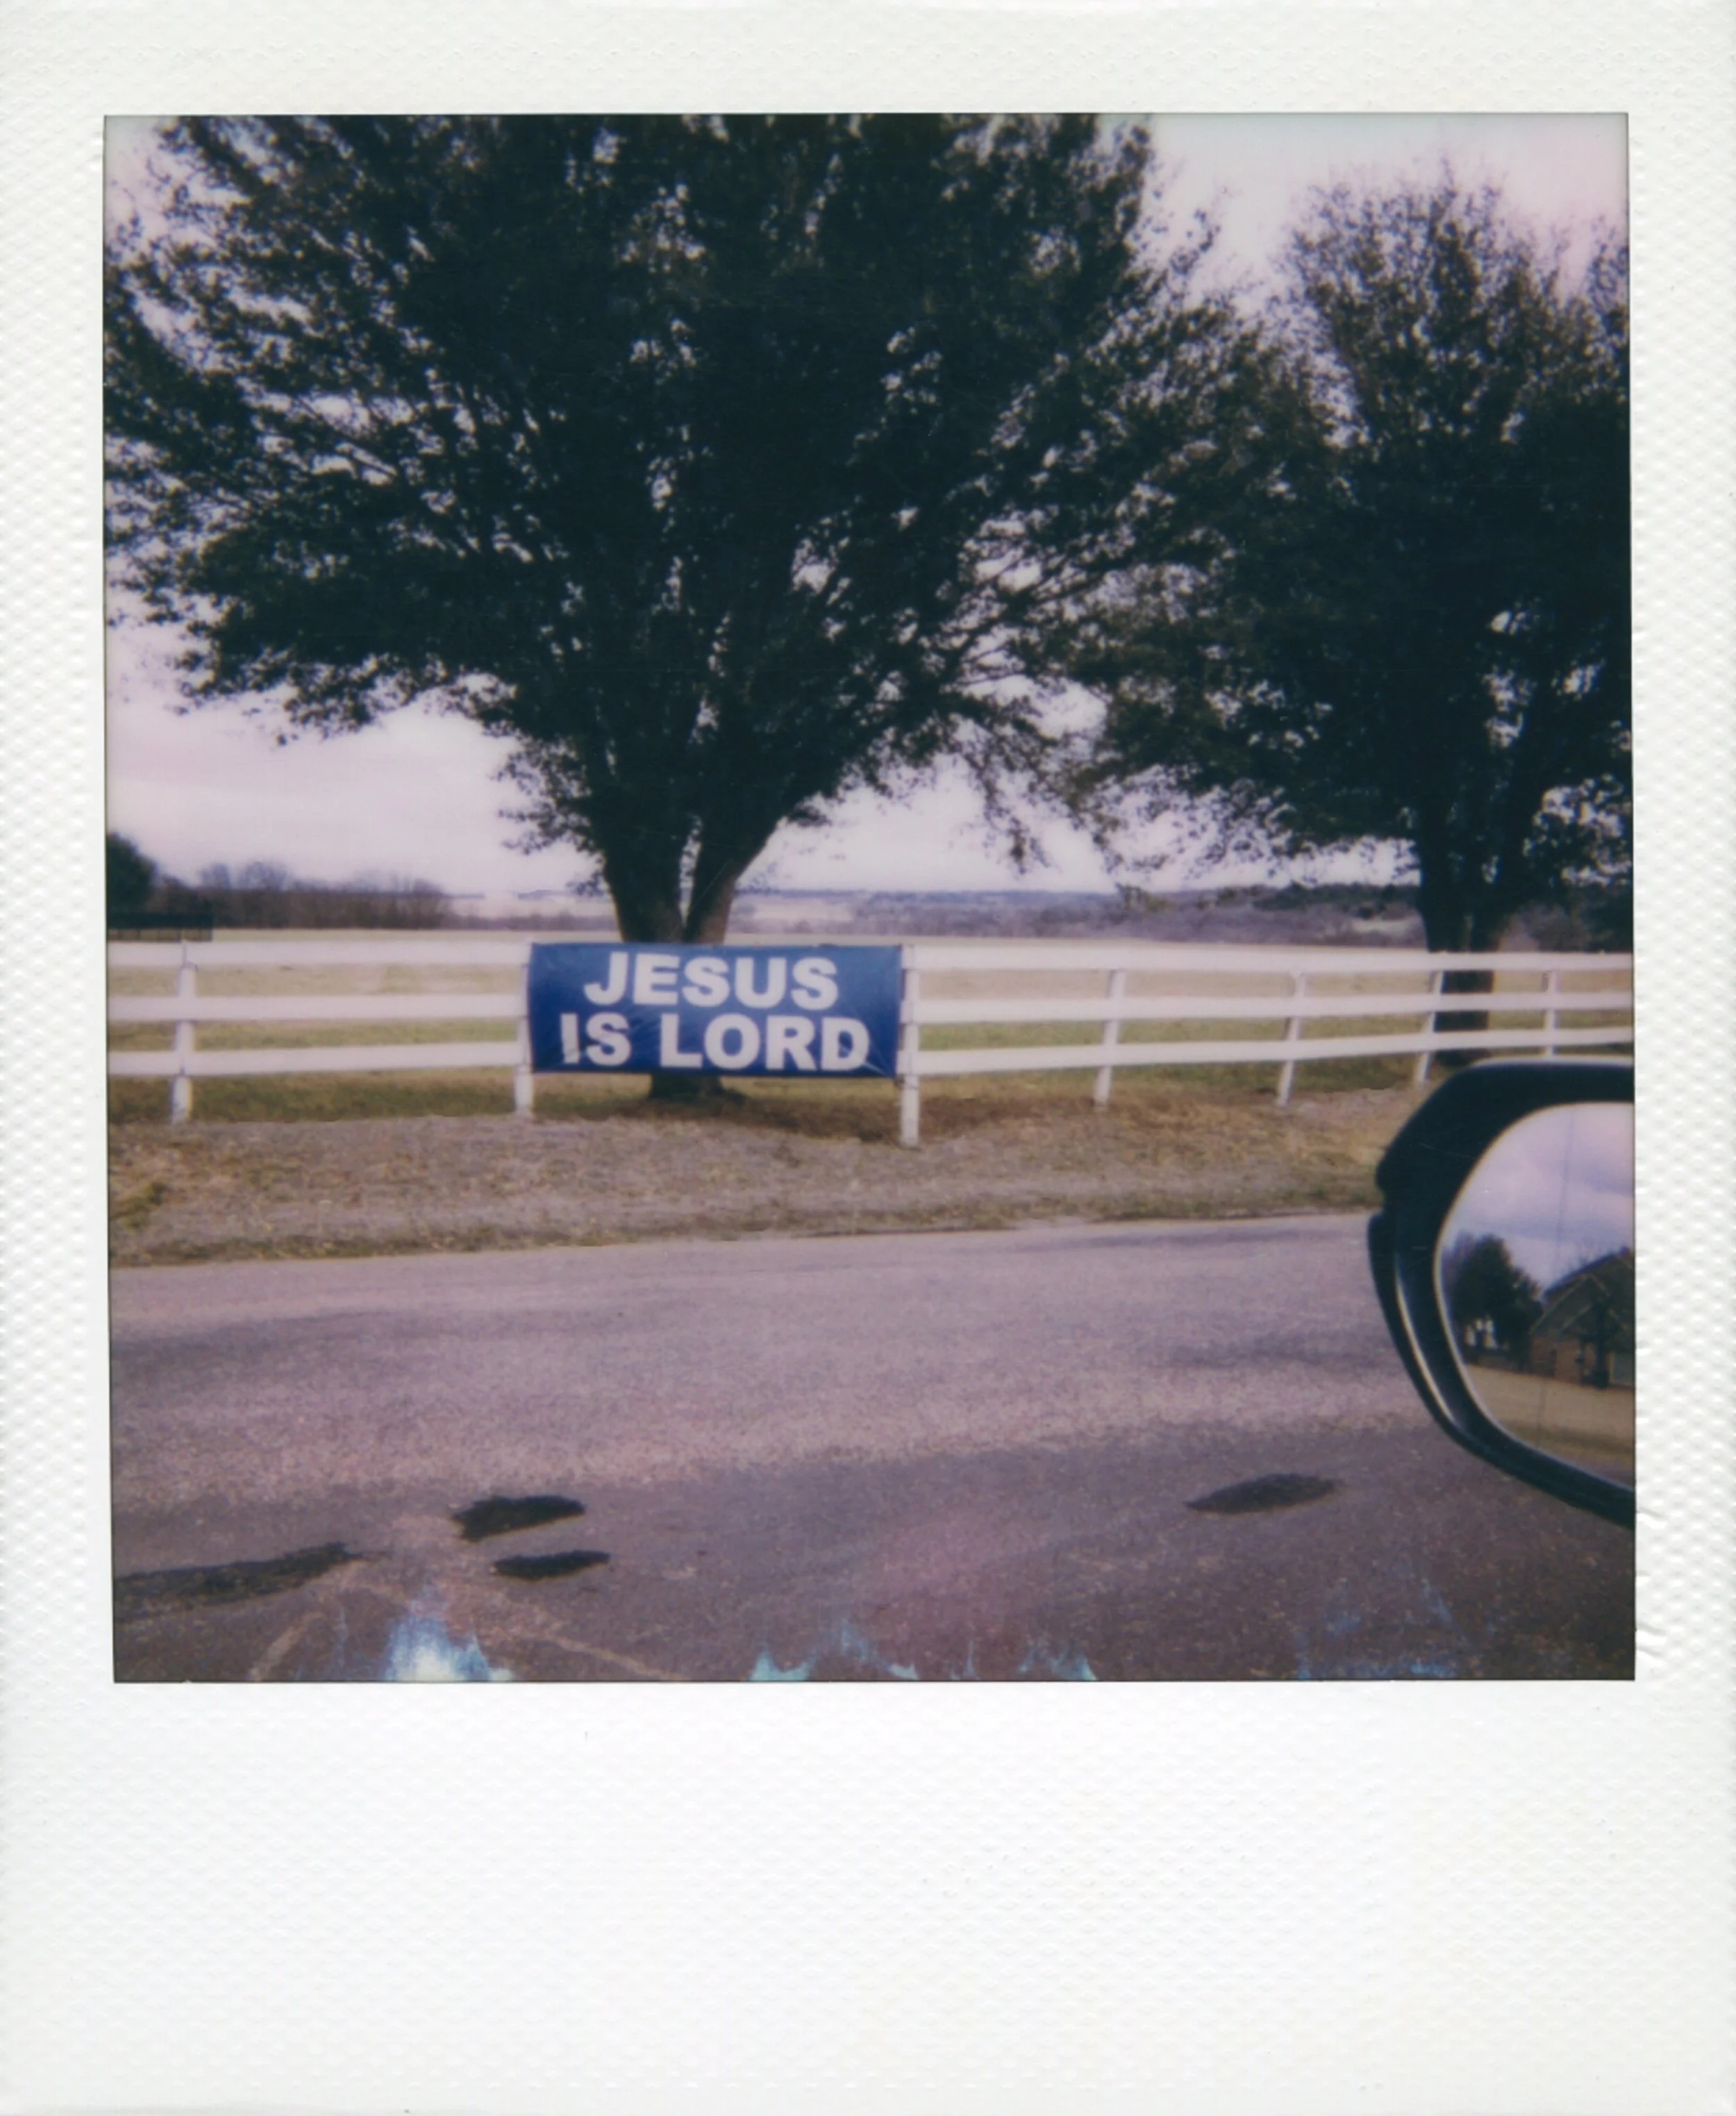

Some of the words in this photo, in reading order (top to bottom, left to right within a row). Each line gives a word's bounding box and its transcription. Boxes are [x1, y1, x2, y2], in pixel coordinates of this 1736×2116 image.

[583, 951, 839, 1010] JESUS
[560, 1013, 631, 1066] IS
[660, 1013, 870, 1071] LORD
